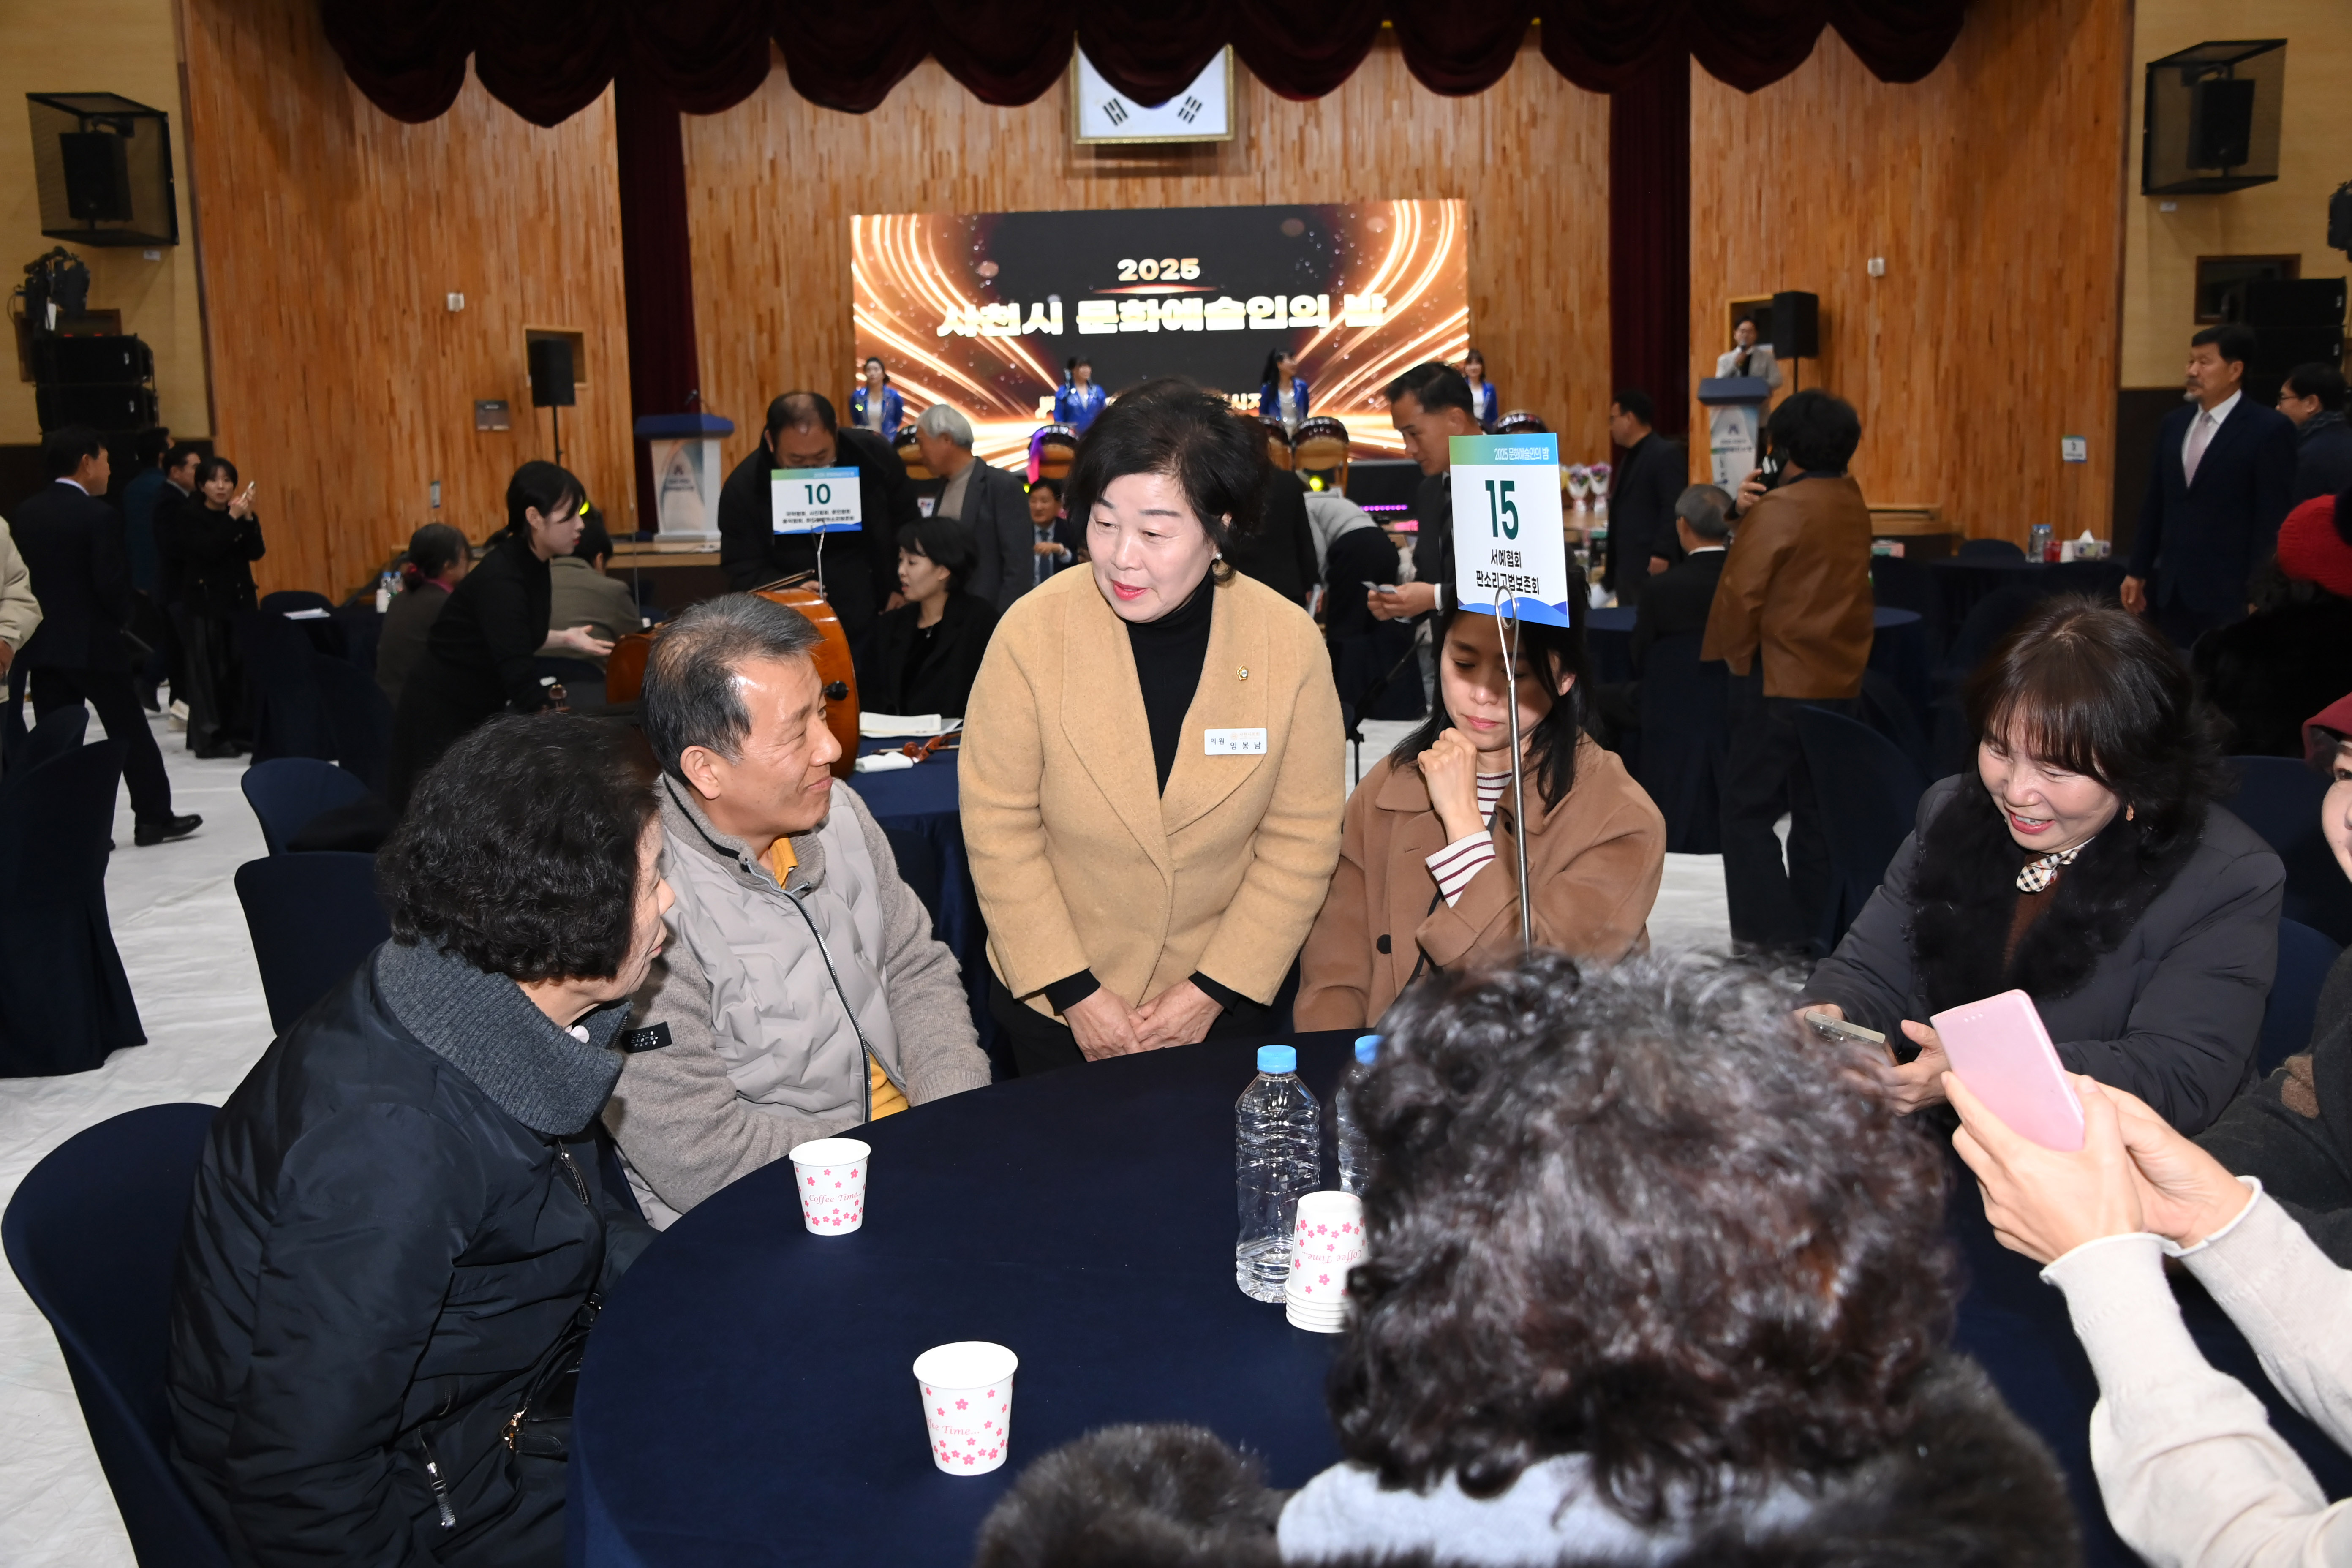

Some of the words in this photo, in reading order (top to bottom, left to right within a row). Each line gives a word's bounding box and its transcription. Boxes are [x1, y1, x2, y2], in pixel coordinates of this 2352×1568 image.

[1117, 258, 1200, 281] 2025
[937, 301, 1063, 337] 사천시
[1076, 294, 1330, 334] 문화예술인의
[1344, 293, 1388, 327] 밤
[1494, 448, 1508, 460] 2025
[1509, 447, 1541, 460] 문화예술인의
[1542, 447, 1549, 460] 밤
[805, 484, 831, 504] 10
[1485, 480, 1519, 540] 15
[1491, 549, 1522, 569] 서예협회
[1476, 570, 1540, 595] 판소리고법보존회
[809, 1194, 834, 1205] Coffee
[1337, 1249, 1362, 1264] Coffee
